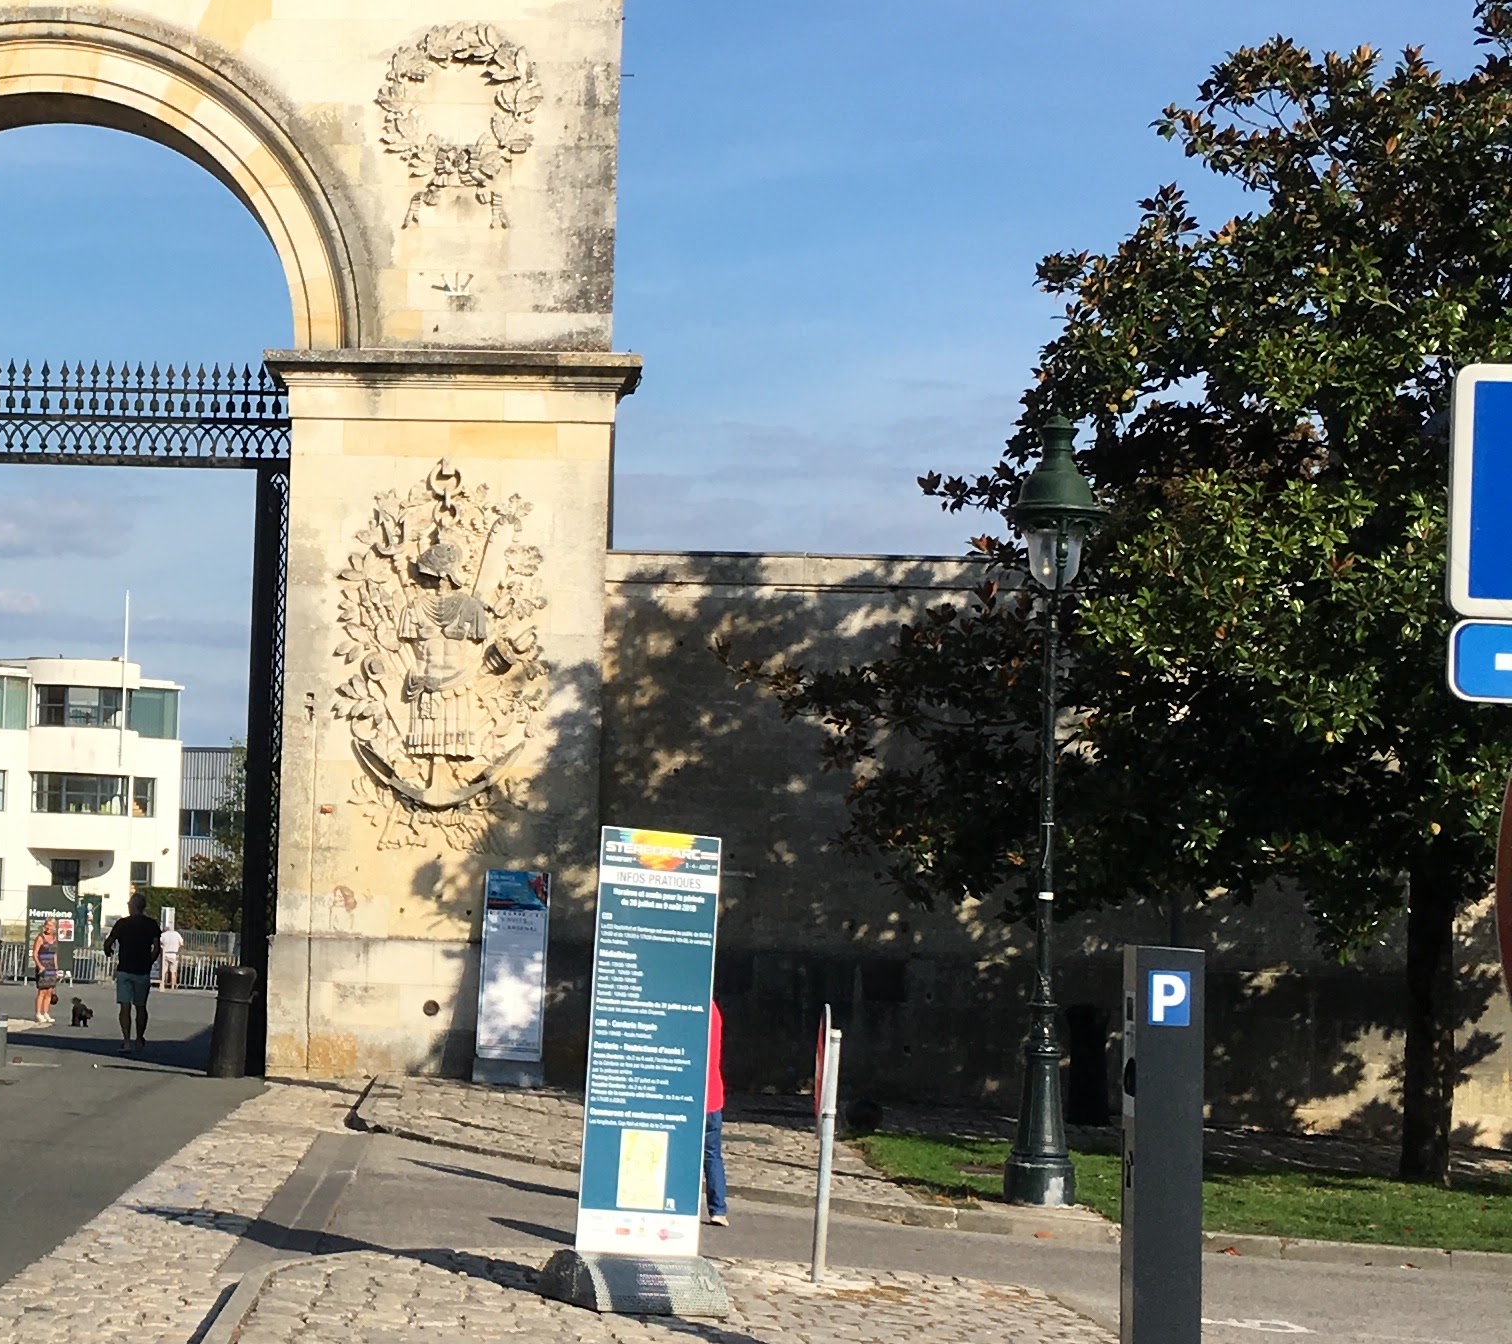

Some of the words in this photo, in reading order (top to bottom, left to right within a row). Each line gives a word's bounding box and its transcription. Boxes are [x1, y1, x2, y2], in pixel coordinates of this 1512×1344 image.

[605, 841, 701, 861] STEREOPARC
[616, 872, 646, 884] INFOS
[649, 875, 701, 889] PRATIQUES
[29, 909, 72, 918] Hermione
[1152, 974, 1186, 1022] P
